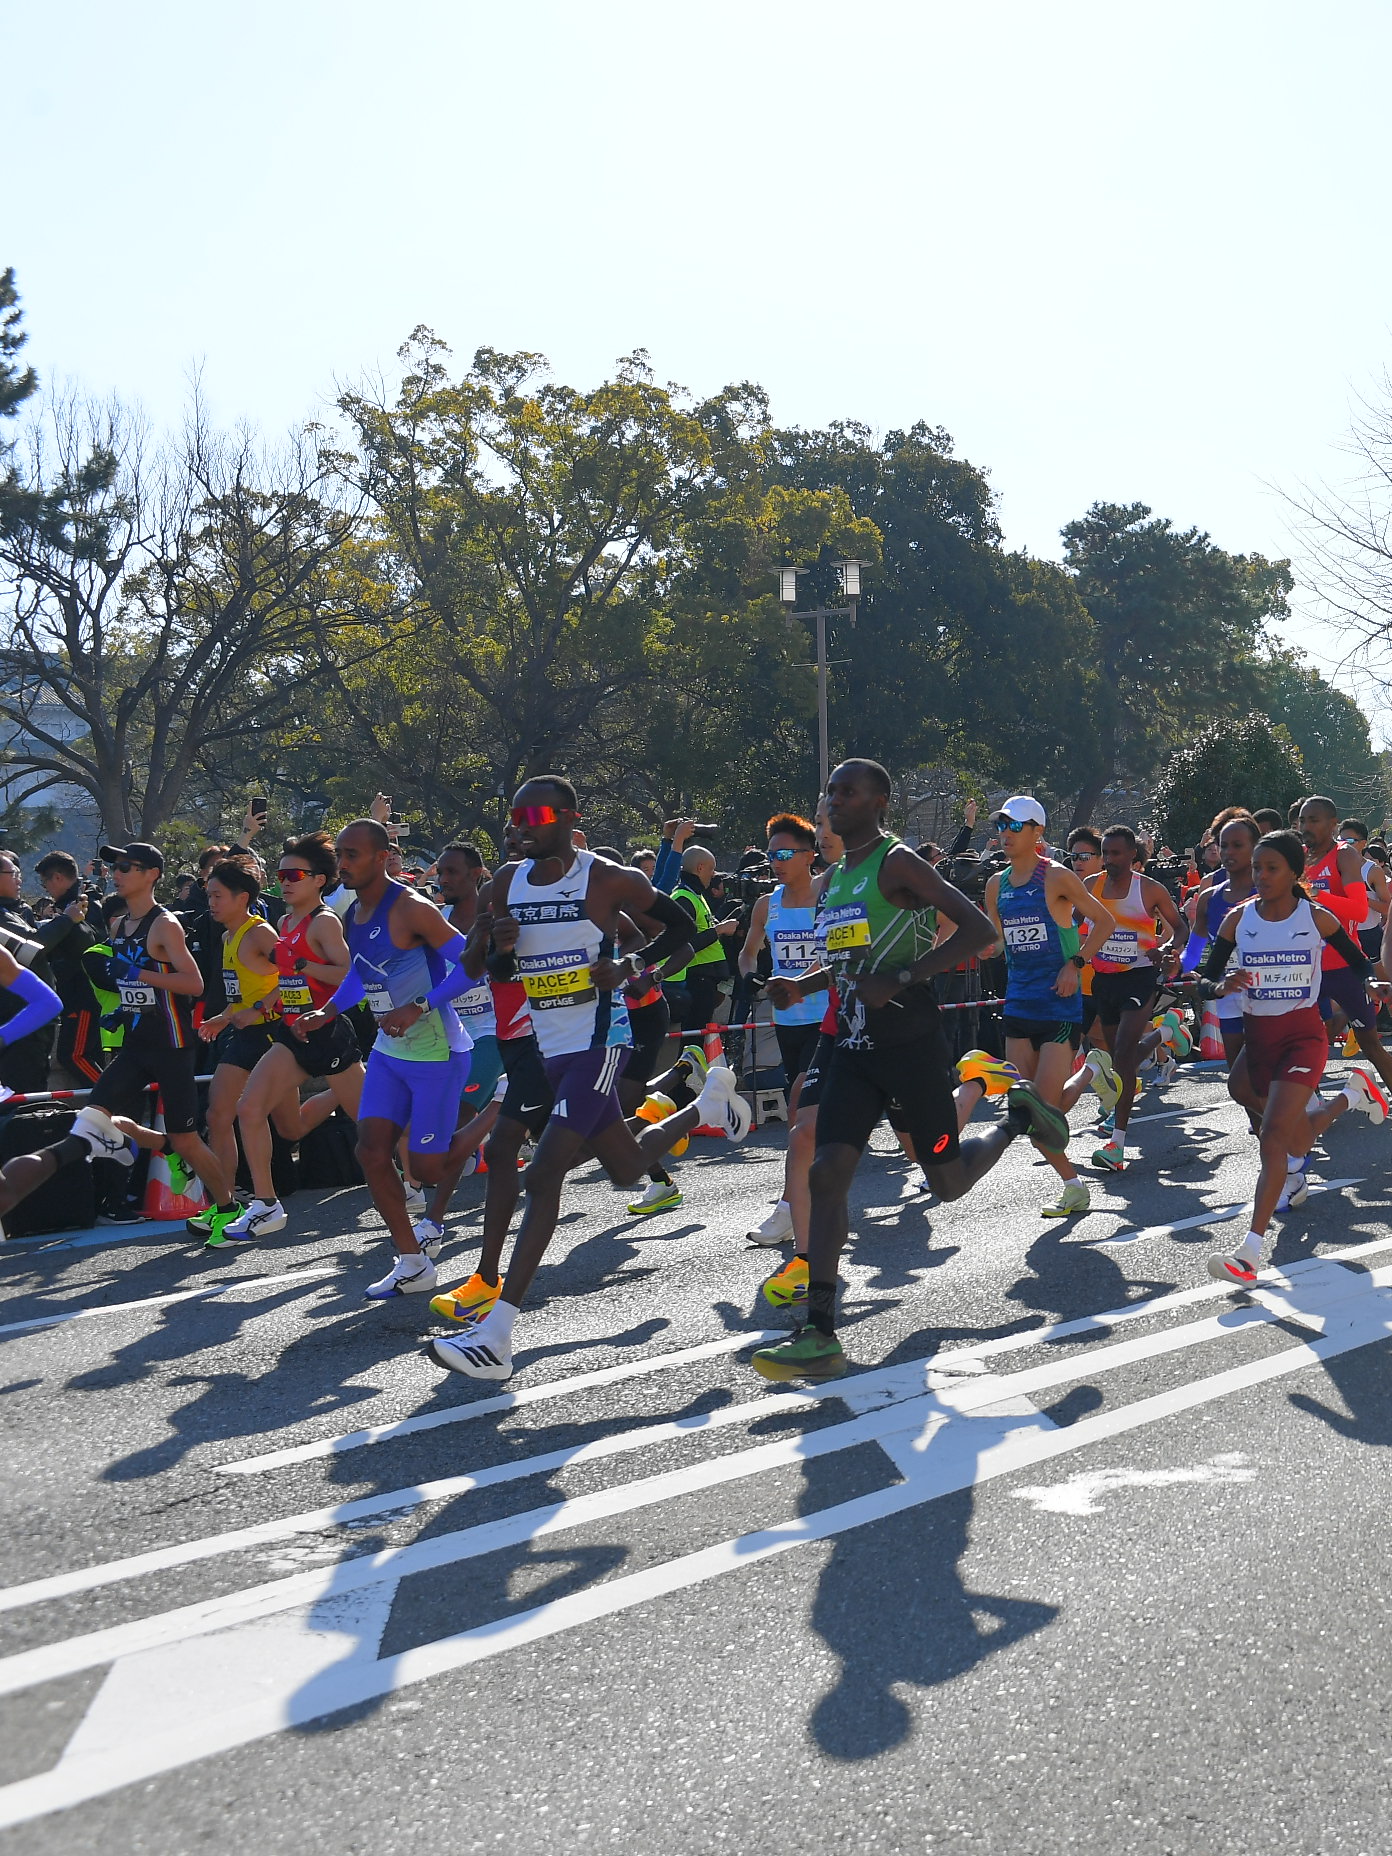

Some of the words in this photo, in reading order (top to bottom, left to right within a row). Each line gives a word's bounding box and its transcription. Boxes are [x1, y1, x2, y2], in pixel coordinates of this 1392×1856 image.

[840, 906, 862, 917] Metro
[1003, 918, 1020, 926] Osaka
[1020, 916, 1040, 925] Metro
[777, 932, 801, 940] Osaka
[828, 925, 855, 941] ACE1
[1008, 928, 1040, 943] 132
[520, 959, 547, 970] Osaka
[548, 954, 582, 967] Metro
[1245, 955, 1275, 964] Osaka
[1276, 953, 1307, 963] Metro
[529, 971, 580, 989] PACE2
